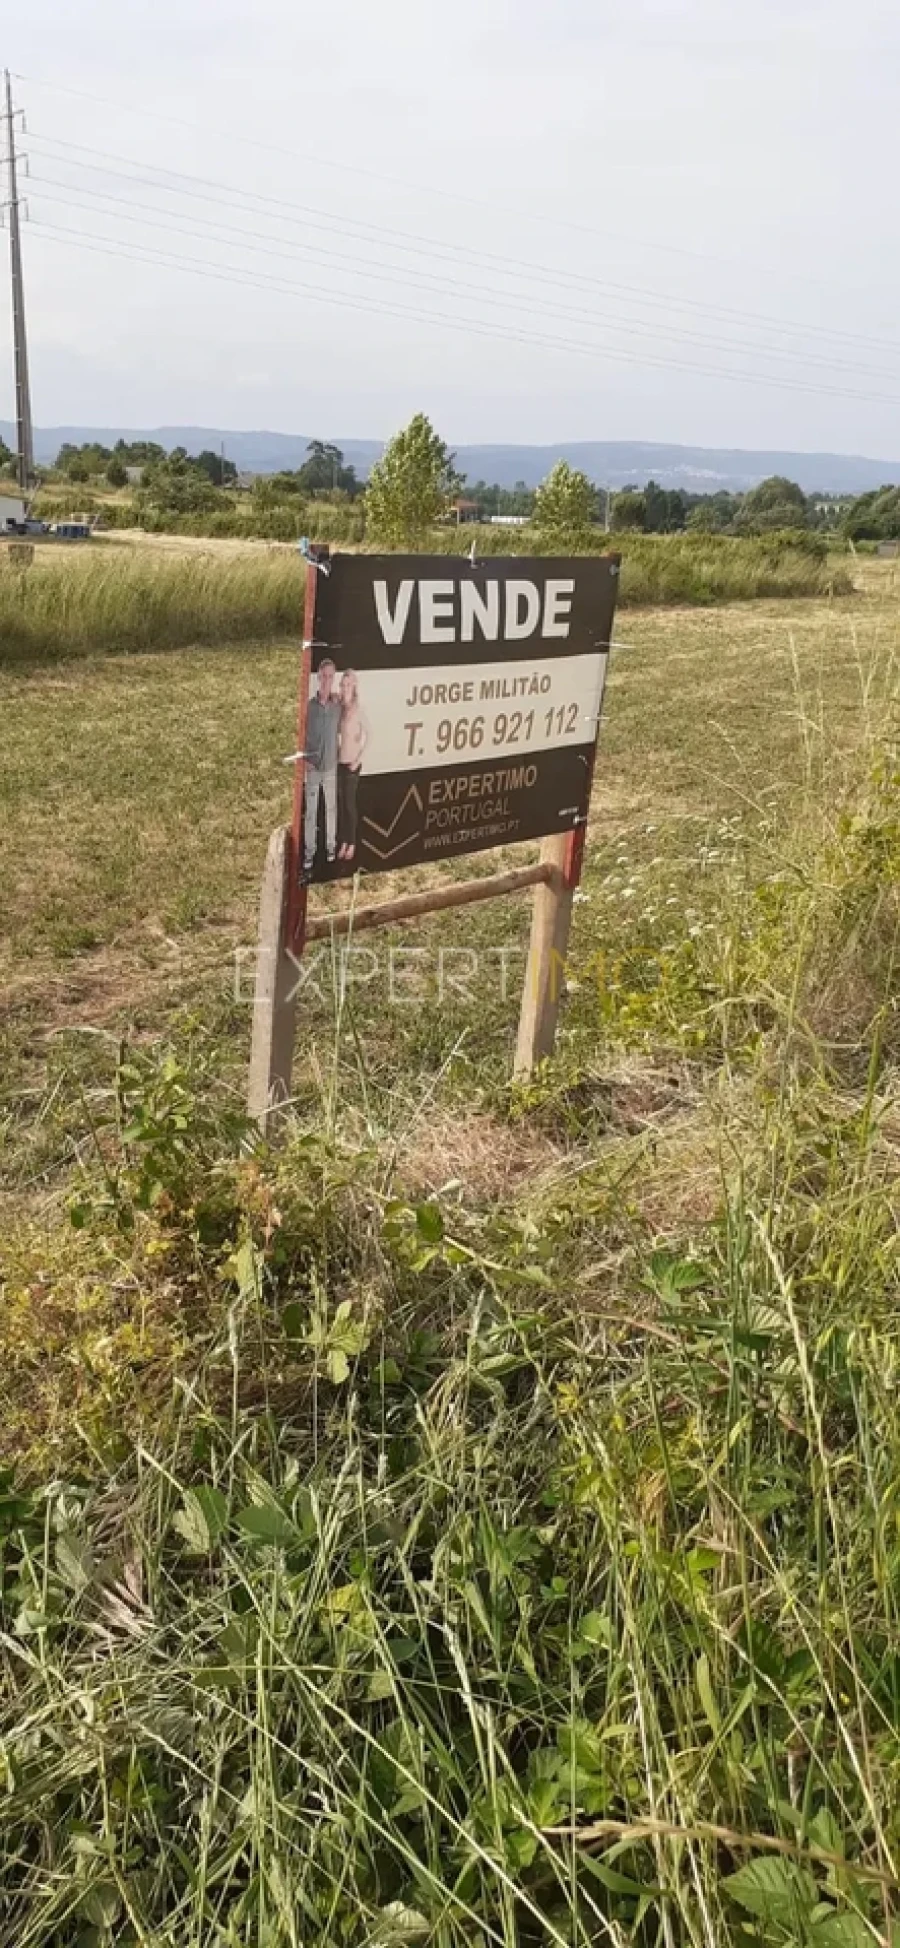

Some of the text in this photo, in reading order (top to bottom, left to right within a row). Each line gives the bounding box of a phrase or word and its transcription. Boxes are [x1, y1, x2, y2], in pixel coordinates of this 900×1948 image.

[373, 579, 575, 645] VENDE
[406, 673, 551, 706] JORGE MILITÃO
[404, 702, 578, 756] T. 966 921 112
[428, 764, 538, 804] EXPERTIMO
[424, 797, 511, 830] PORTUGAL
[423, 819, 521, 850] WWW.EXPERTIMO.PT
